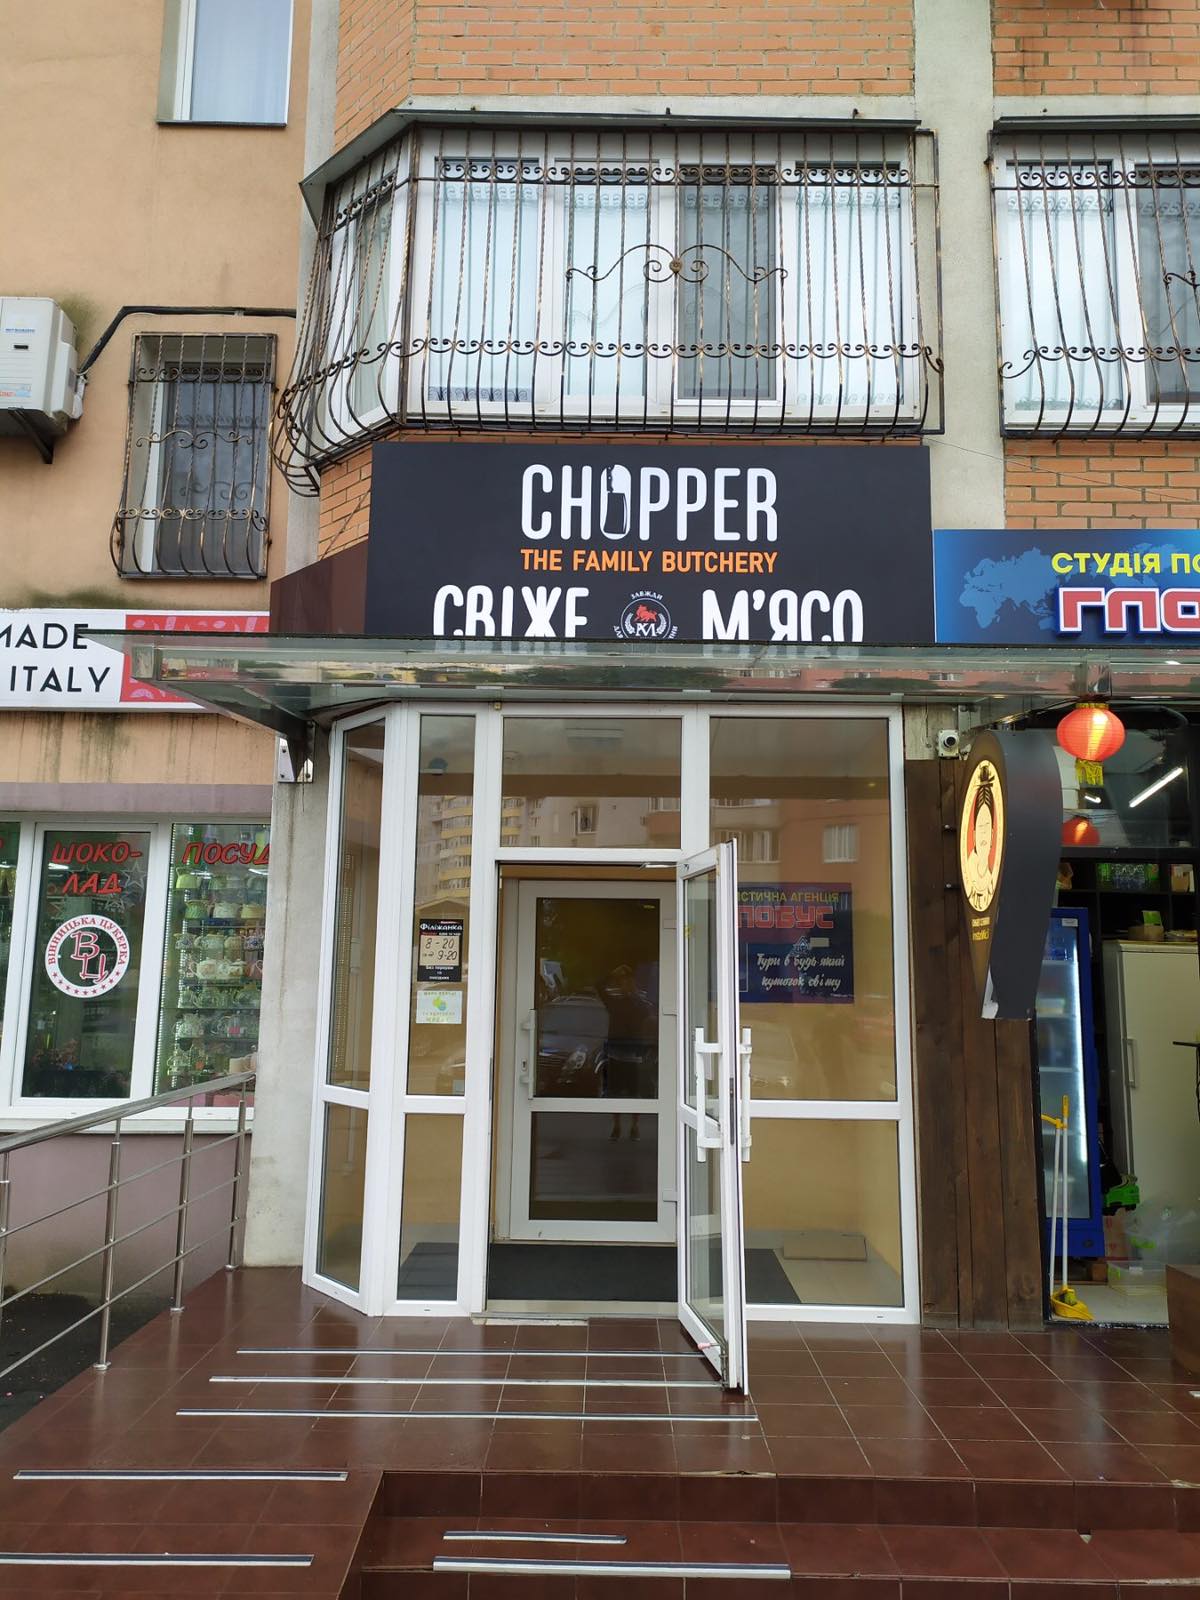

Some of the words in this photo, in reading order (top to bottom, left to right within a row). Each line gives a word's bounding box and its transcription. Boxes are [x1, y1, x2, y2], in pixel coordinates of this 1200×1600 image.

[521, 464, 778, 542] CHOPPER
[521, 549, 562, 571] THE
[573, 550, 652, 572] FAMILY
[662, 551, 778, 573] BUTCHERY
[1051, 552, 1161, 577] СТУДІЯ
[433, 585, 590, 638] СВІЖЕ
[10, 665, 110, 693] ITALY
[51, 841, 143, 864] ШОКО-
[62, 872, 122, 894] ЛАД
[48, 916, 97, 966] ВІННИЦЬКА
[99, 918, 129, 966] ЦУКЕРКА
[442, 937, 455, 949] 20
